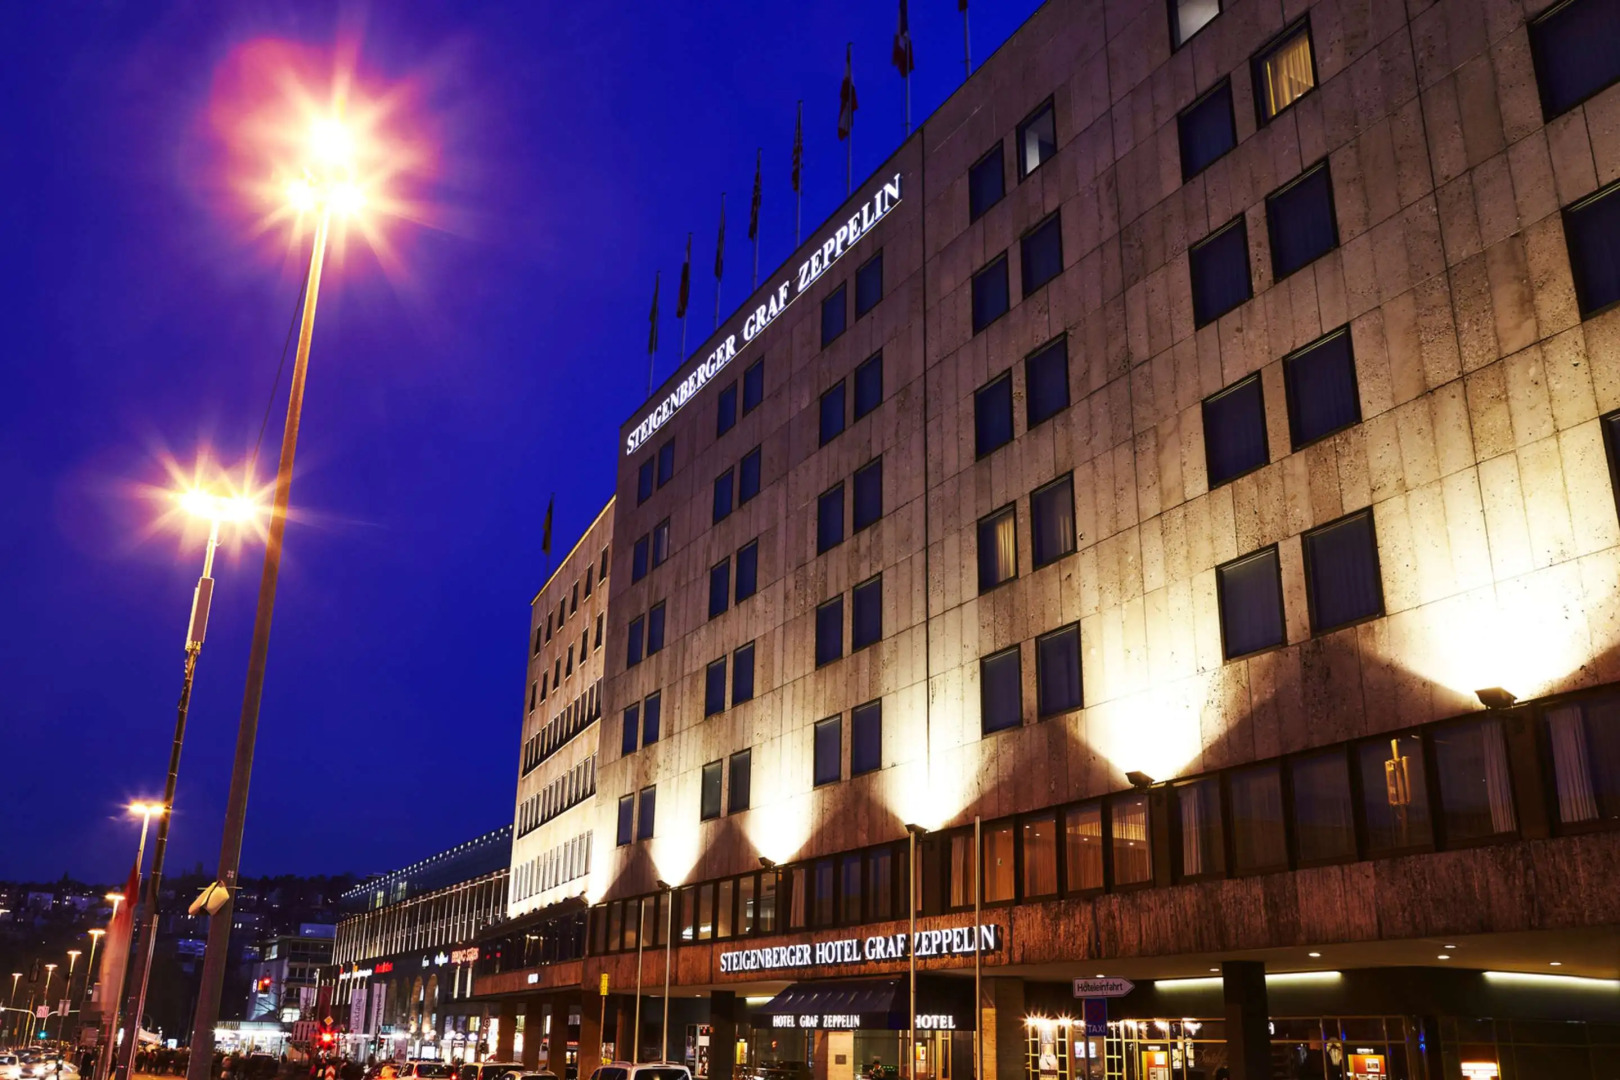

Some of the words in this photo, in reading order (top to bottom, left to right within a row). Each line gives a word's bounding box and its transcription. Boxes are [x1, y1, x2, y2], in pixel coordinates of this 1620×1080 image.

[626, 334, 736, 456] STEIGENBERGER
[743, 280, 790, 341] GRAF
[797, 173, 901, 293] ZEPPELIN
[720, 943, 811, 972] STEIGENBERGER
[815, 938, 861, 964] HOTEL
[864, 933, 906, 960] GRAF
[914, 924, 995, 956] ZEPPELIN
[772, 1014, 796, 1028] HOTEL
[799, 1014, 819, 1028] GRAF
[822, 1014, 860, 1028] ZEPPELIN
[915, 1014, 956, 1029] HOTEL
[1087, 1024, 1106, 1033] TAXI
